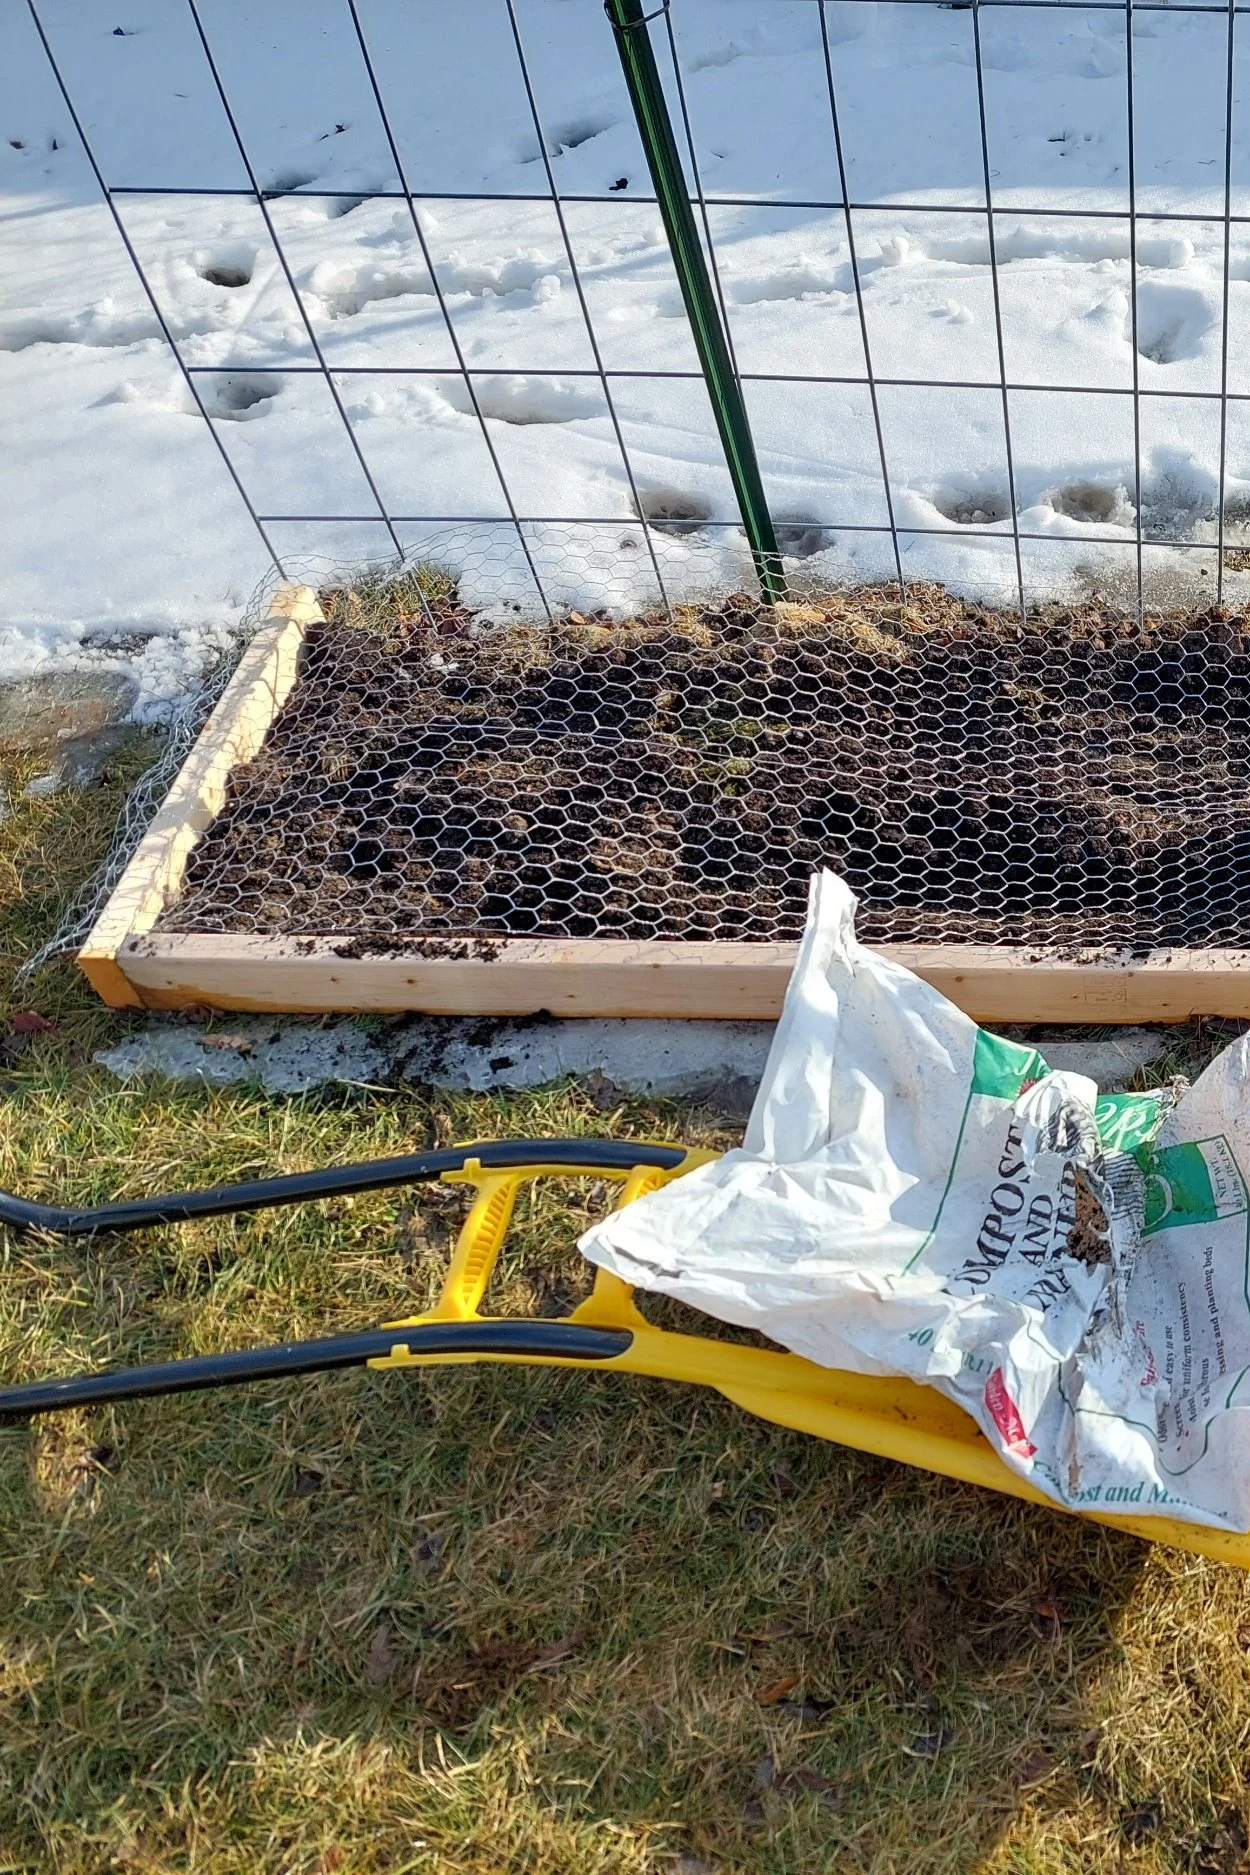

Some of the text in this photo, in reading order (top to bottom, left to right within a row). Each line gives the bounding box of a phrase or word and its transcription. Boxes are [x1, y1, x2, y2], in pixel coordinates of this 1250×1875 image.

[954, 1123, 1031, 1294] OMPOST
[1018, 1194, 1054, 1268] AND
[1202, 1246, 1214, 1268] beds
[1204, 1268, 1219, 1314] planting
[1177, 1281, 1191, 1342] consistency
[1210, 1316, 1221, 1338] and
[1164, 1325, 1173, 1340] use
[1165, 1350, 1178, 1375] easy
[1182, 1344, 1192, 1386] uniform
[1104, 1480, 1146, 1503] and
